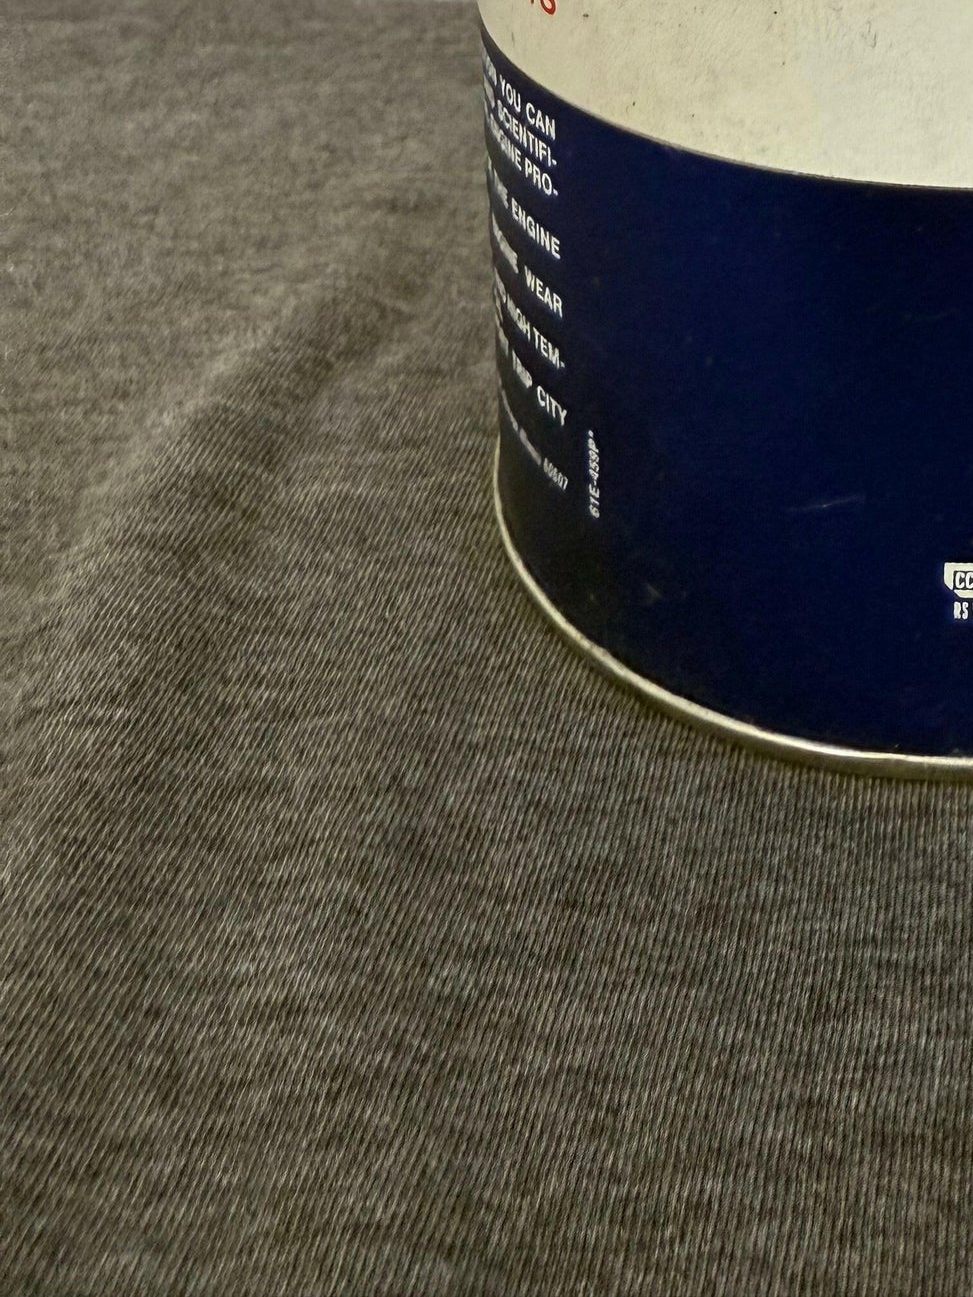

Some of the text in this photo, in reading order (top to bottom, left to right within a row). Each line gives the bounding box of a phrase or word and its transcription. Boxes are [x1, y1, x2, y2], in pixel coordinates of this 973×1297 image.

[499, 73, 521, 114] YOU
[526, 102, 556, 141] CAN
[524, 157, 559, 197] PRO-
[511, 197, 561, 260] ENGINE
[525, 264, 563, 319] WEAR
[533, 327, 566, 370] TEM-
[536, 385, 567, 427] CITY
